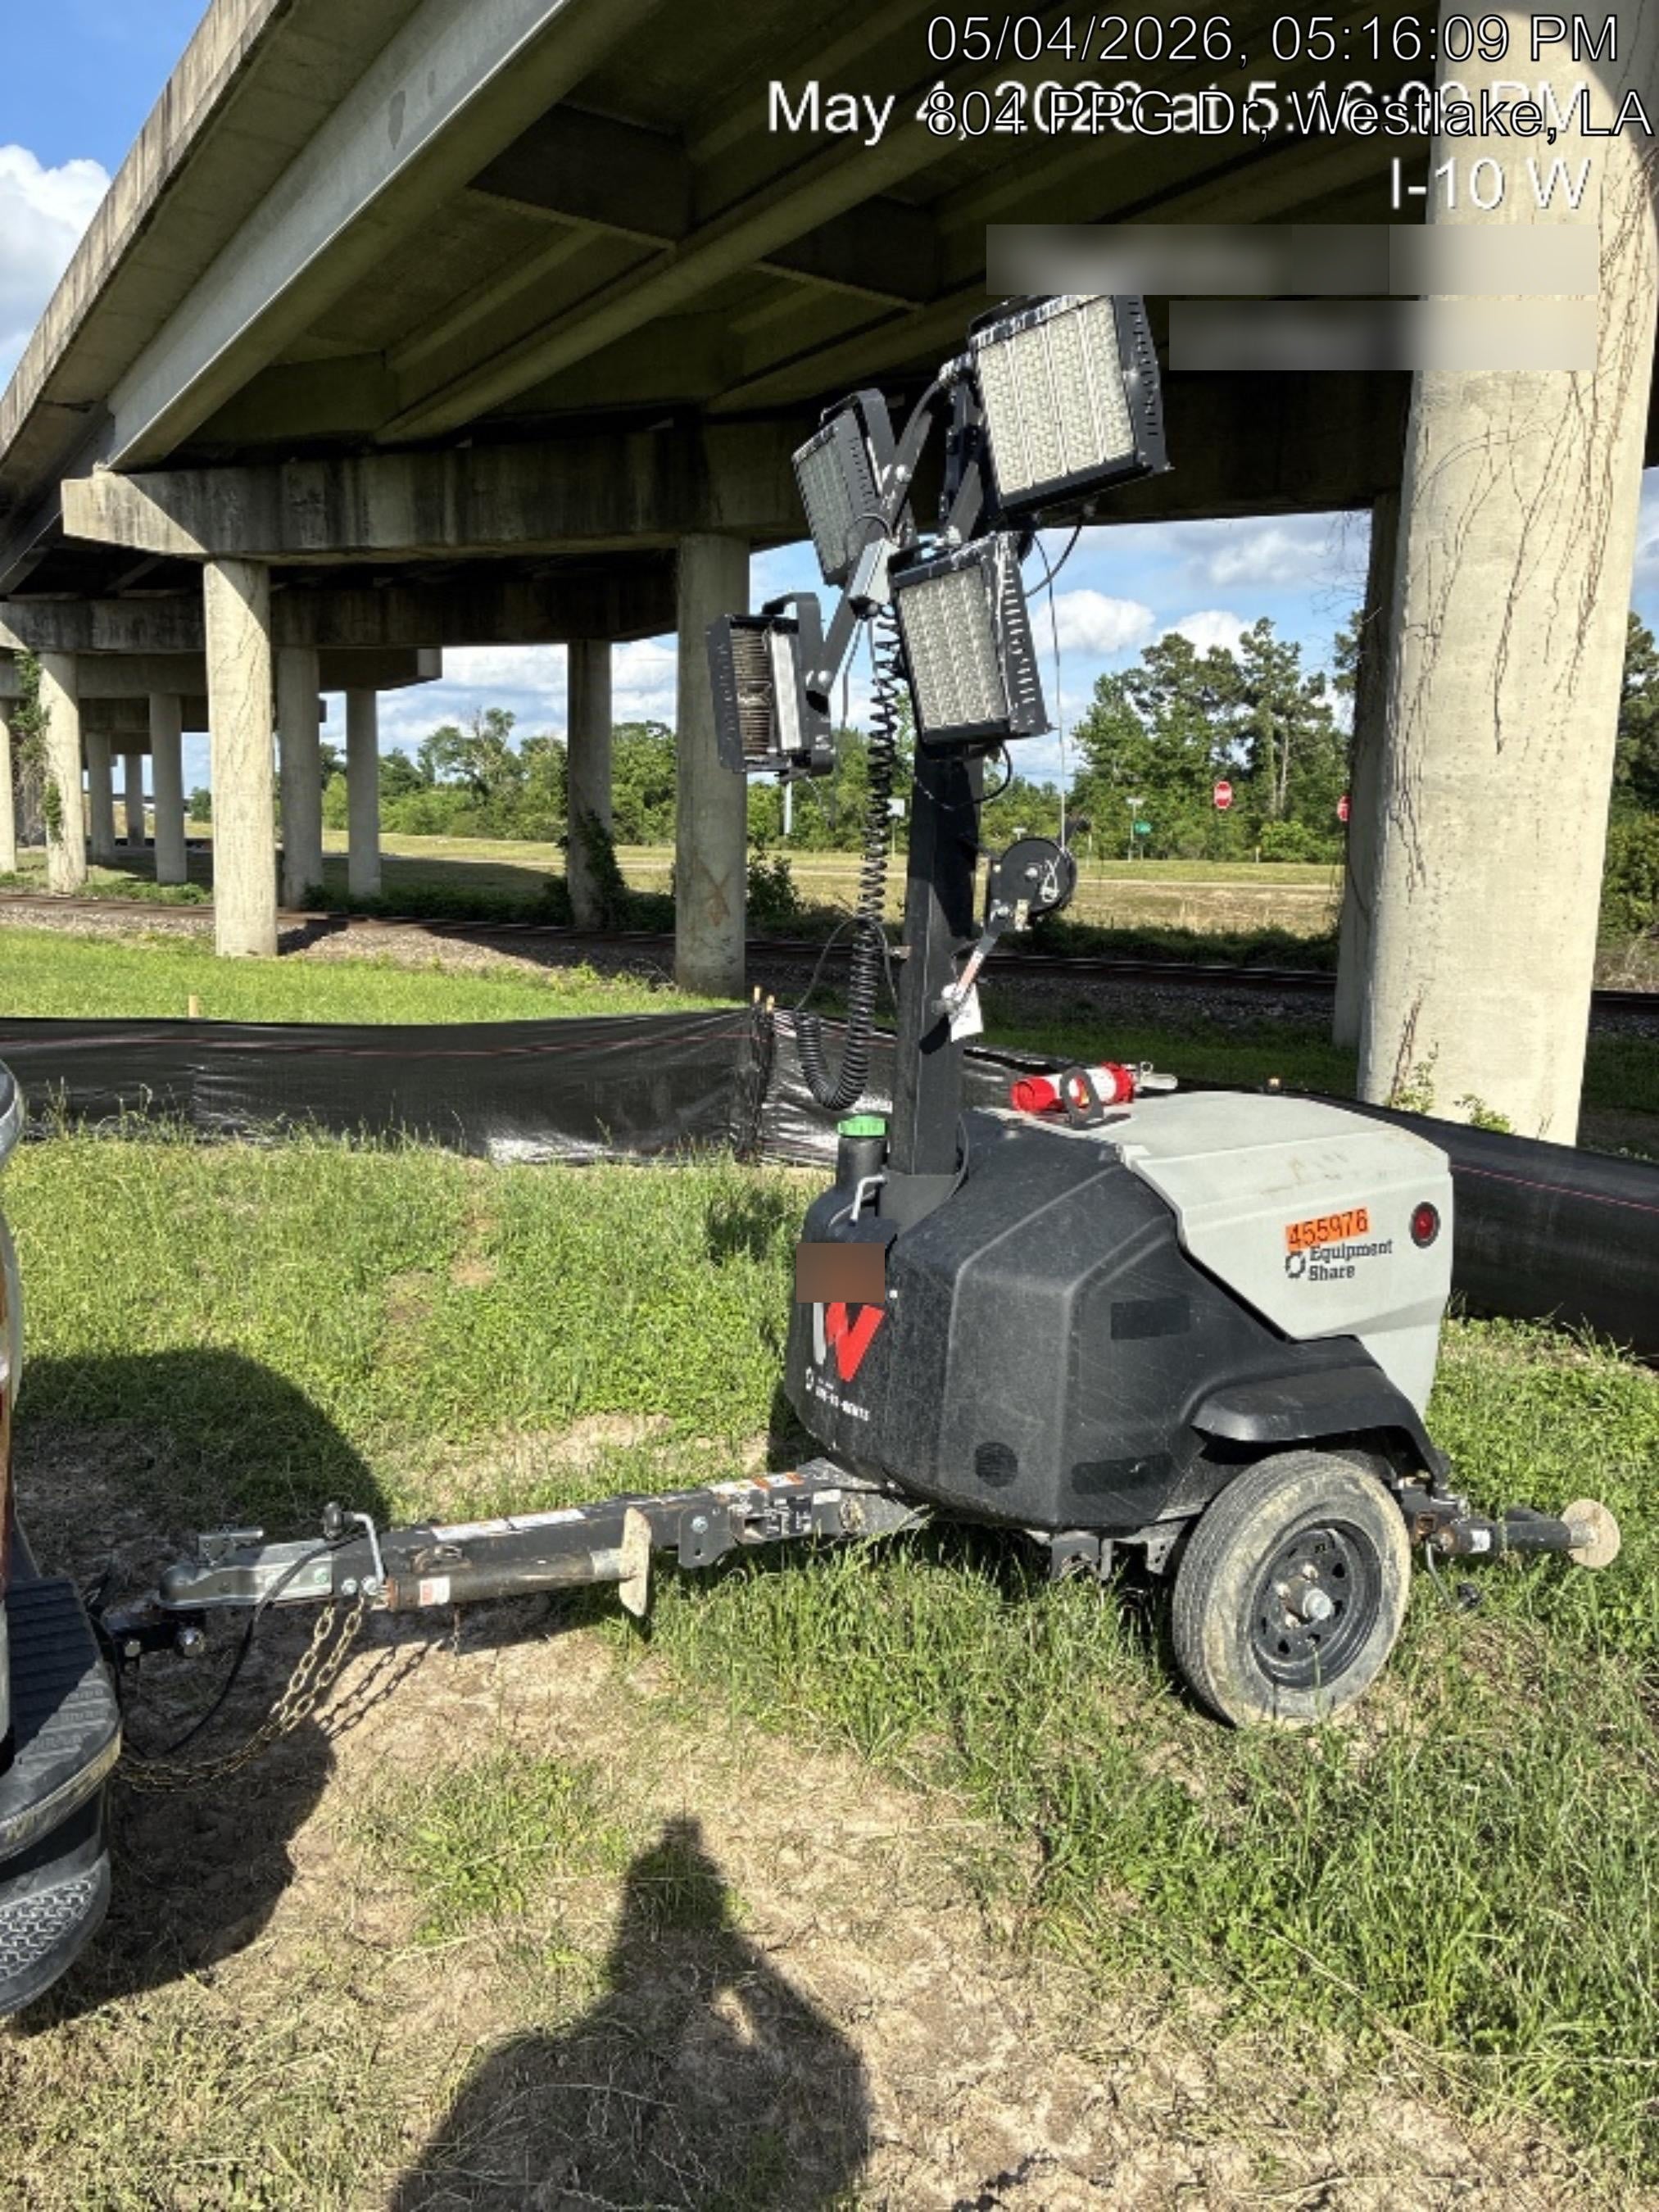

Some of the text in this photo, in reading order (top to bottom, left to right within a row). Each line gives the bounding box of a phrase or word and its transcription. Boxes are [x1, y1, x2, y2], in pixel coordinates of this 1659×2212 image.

[1289, 1208, 1367, 1247] 455976
[1309, 1240, 1393, 1263] Equipment
[1308, 1266, 1355, 1281] Share
